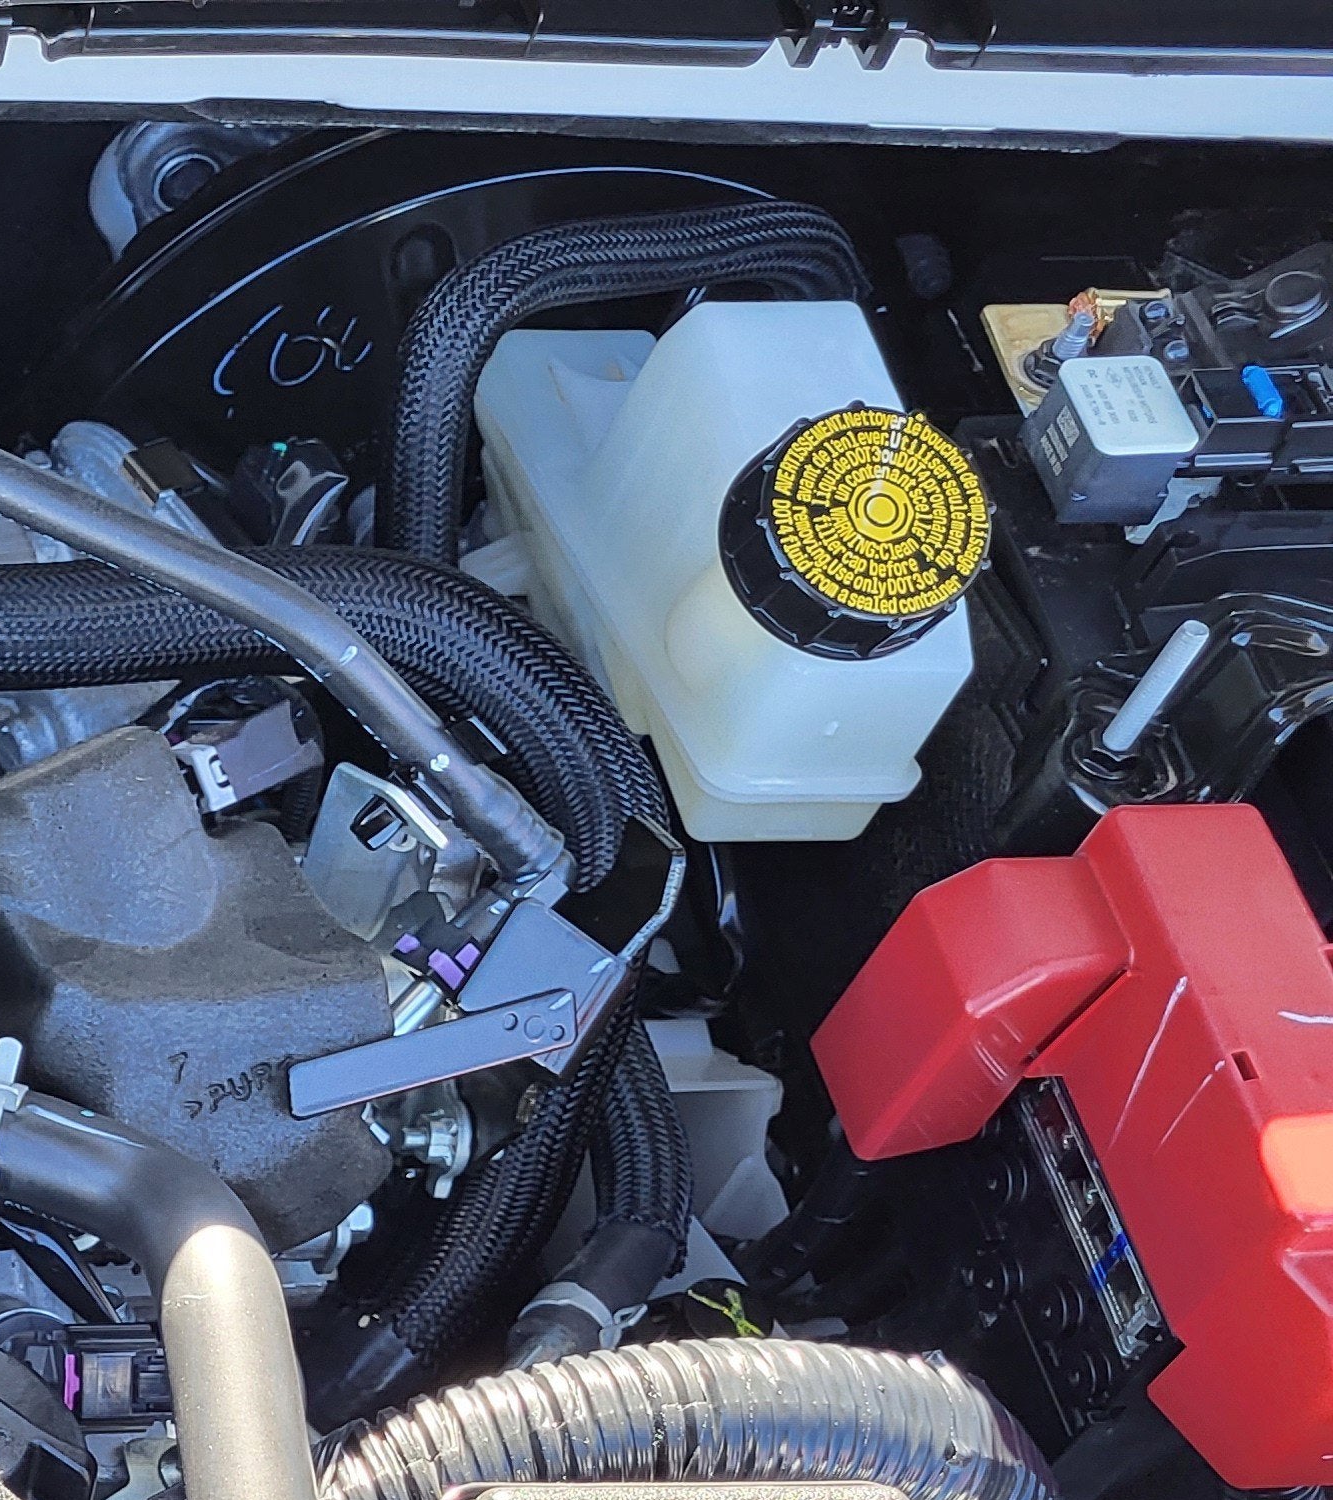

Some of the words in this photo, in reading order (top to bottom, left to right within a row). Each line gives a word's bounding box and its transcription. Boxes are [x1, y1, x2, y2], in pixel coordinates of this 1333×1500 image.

[796, 463, 821, 502] avant
[812, 449, 831, 468] de
[920, 425, 968, 474] bouchon
[834, 483, 852, 502] un
[844, 463, 916, 491] contenant
[919, 478, 947, 548] provenant
[813, 515, 847, 555] filler
[841, 551, 867, 574] cap
[869, 558, 919, 578] before
[780, 534, 813, 572] fluid
[805, 568, 839, 598] from
[837, 589, 849, 604] a
[847, 592, 897, 614] sealed
[899, 574, 962, 613] container
[827, 559, 854, 585] Use
[853, 576, 886, 598] only
